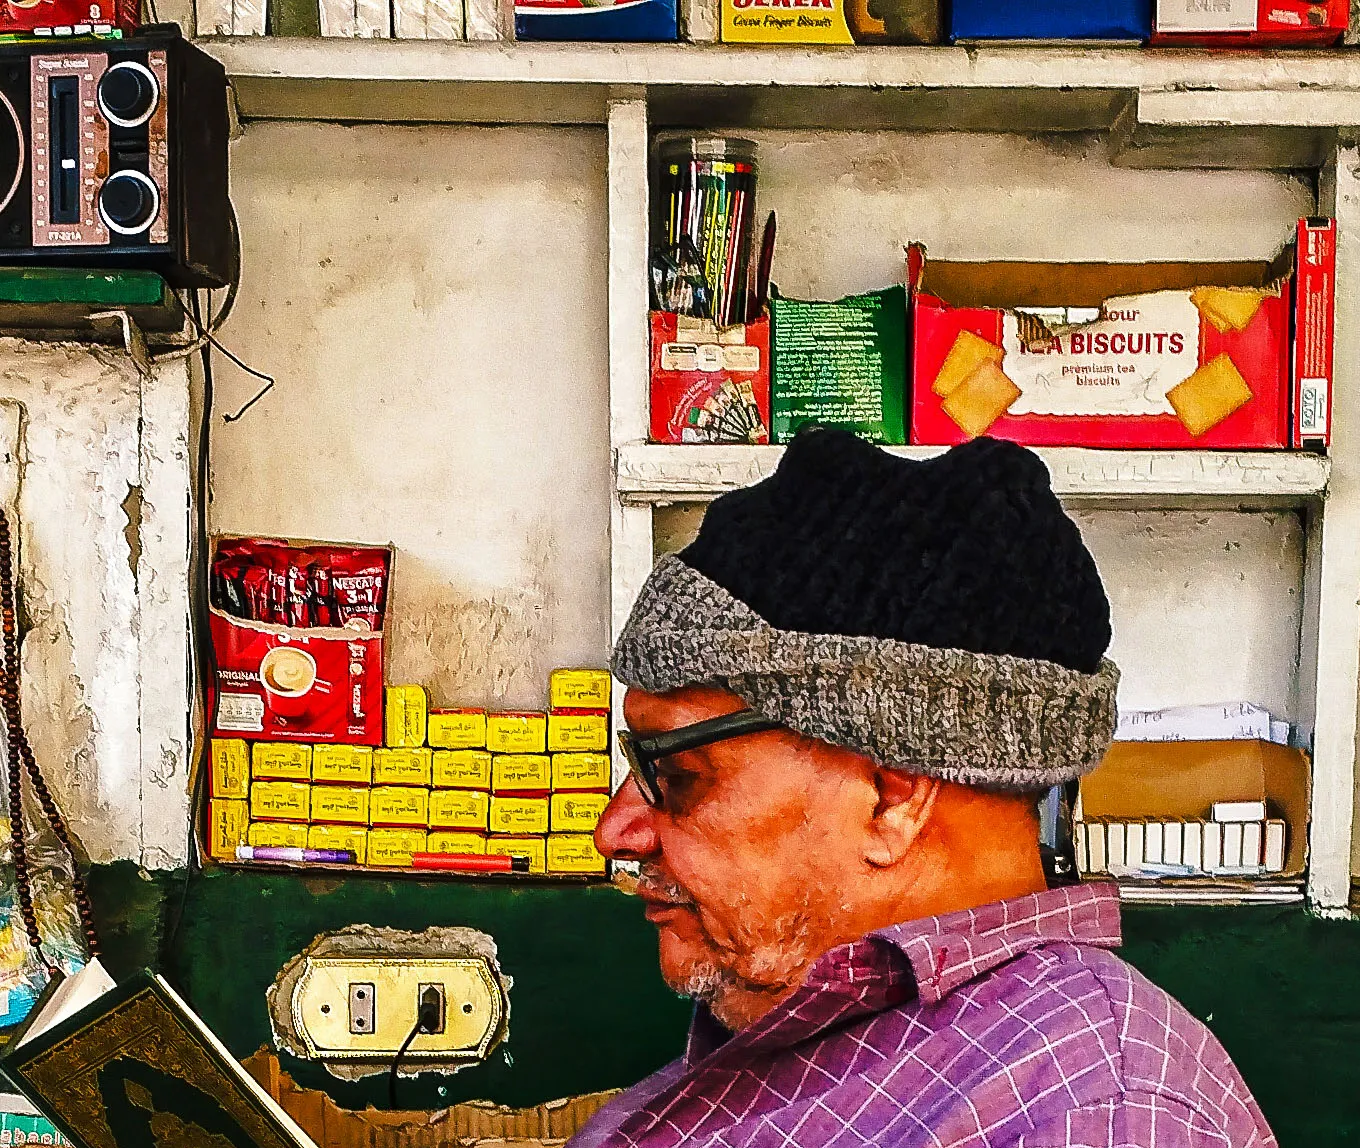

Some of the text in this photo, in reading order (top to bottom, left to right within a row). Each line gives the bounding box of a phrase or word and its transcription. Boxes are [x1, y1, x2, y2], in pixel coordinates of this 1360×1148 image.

[1070, 332, 1185, 355] BISCUITS
[1061, 363, 1136, 376] premium tea
[1076, 374, 1121, 387] biscuits
